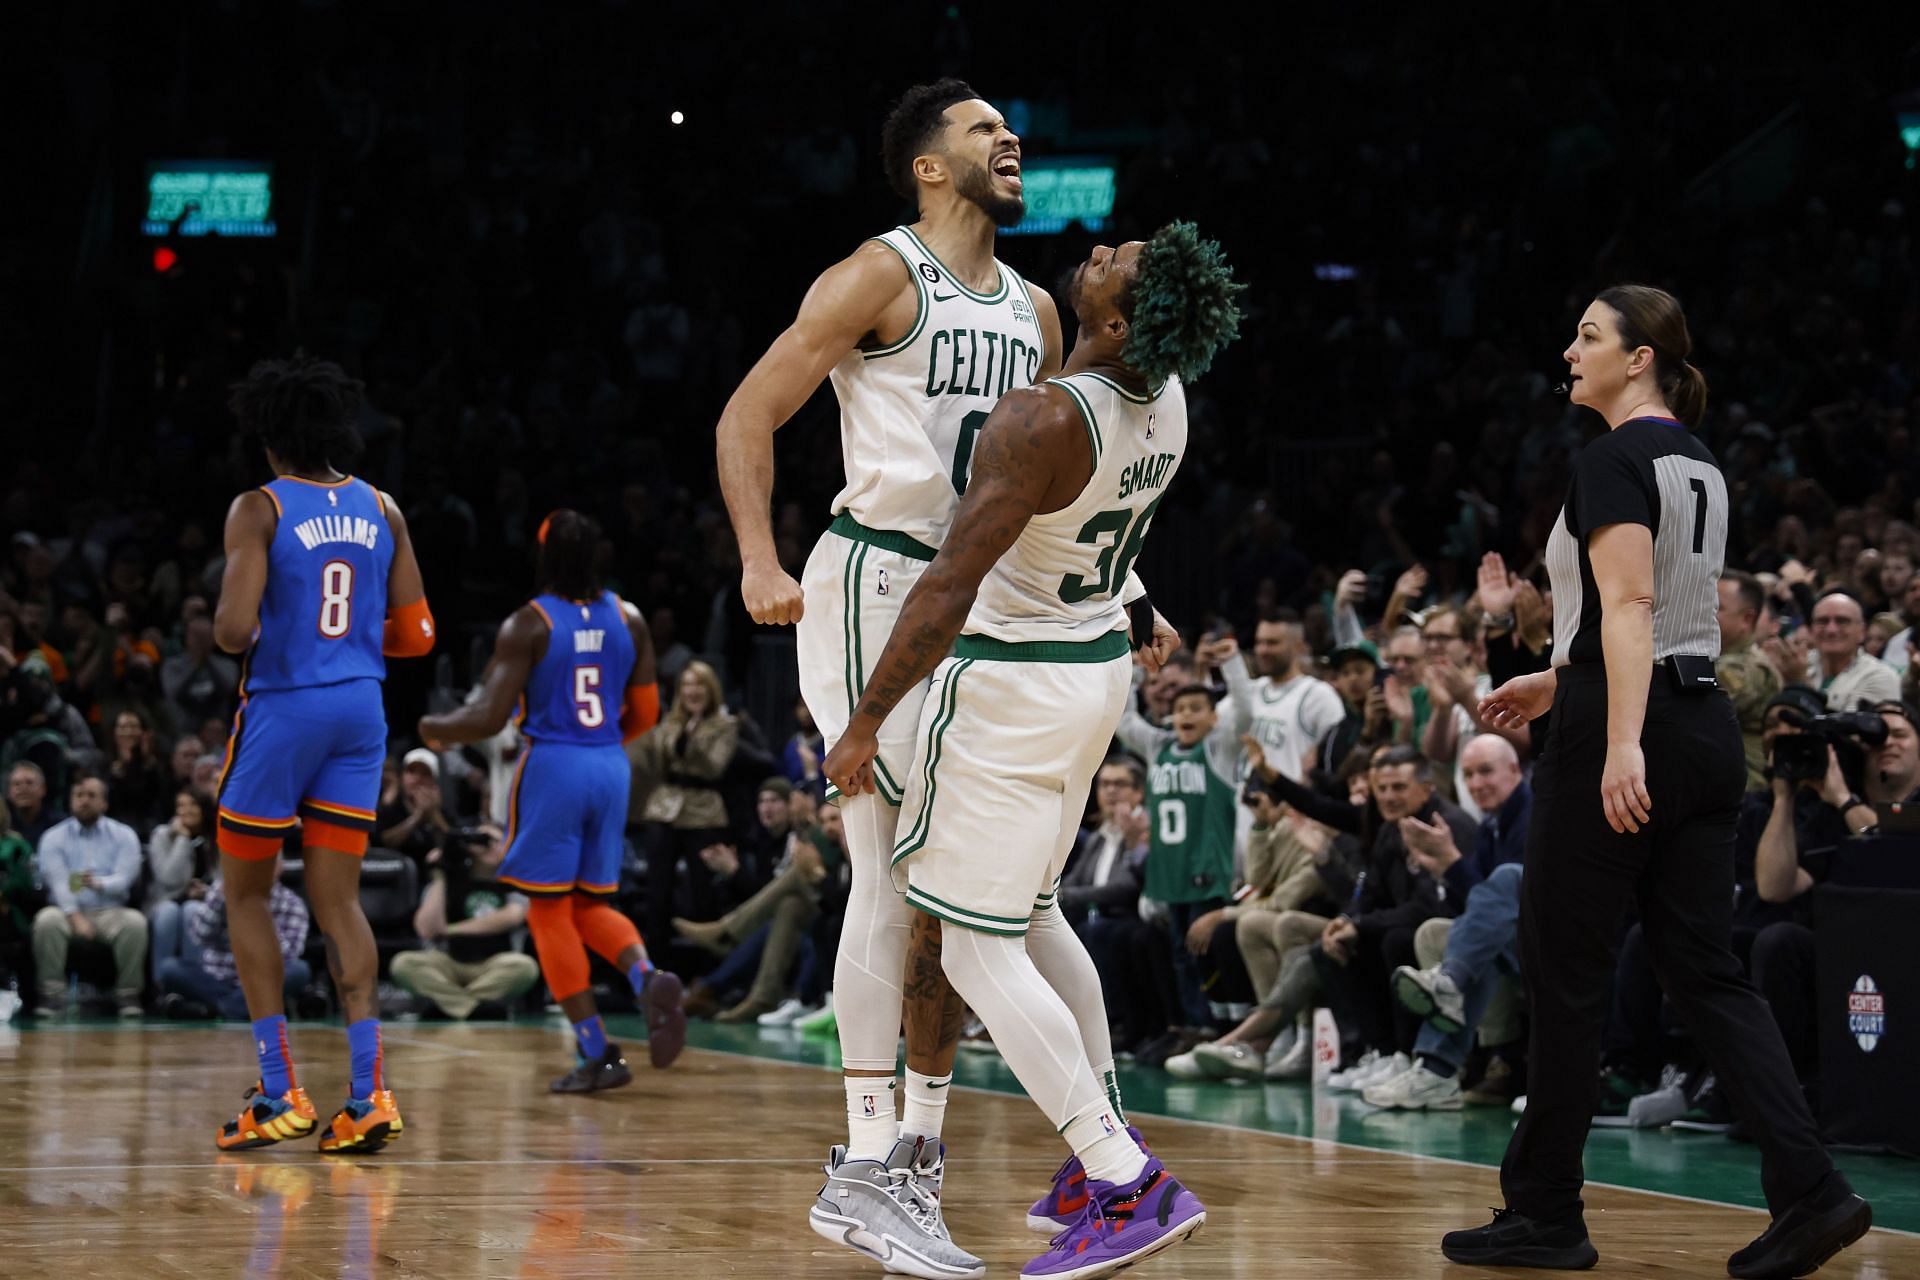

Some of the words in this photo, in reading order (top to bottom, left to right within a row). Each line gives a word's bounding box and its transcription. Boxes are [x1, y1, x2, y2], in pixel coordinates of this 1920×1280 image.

[922, 265, 939, 282] 6
[1010, 299, 1031, 315] VISTA
[1118, 453, 1176, 500] SMART
[294, 515, 378, 550] WILLIAMS
[318, 559, 355, 639] 8
[574, 665, 604, 728] 5
[1158, 799, 1187, 845] 0
[1848, 993, 1884, 1012] CENTER
[1849, 1013, 1884, 1033] COURT
